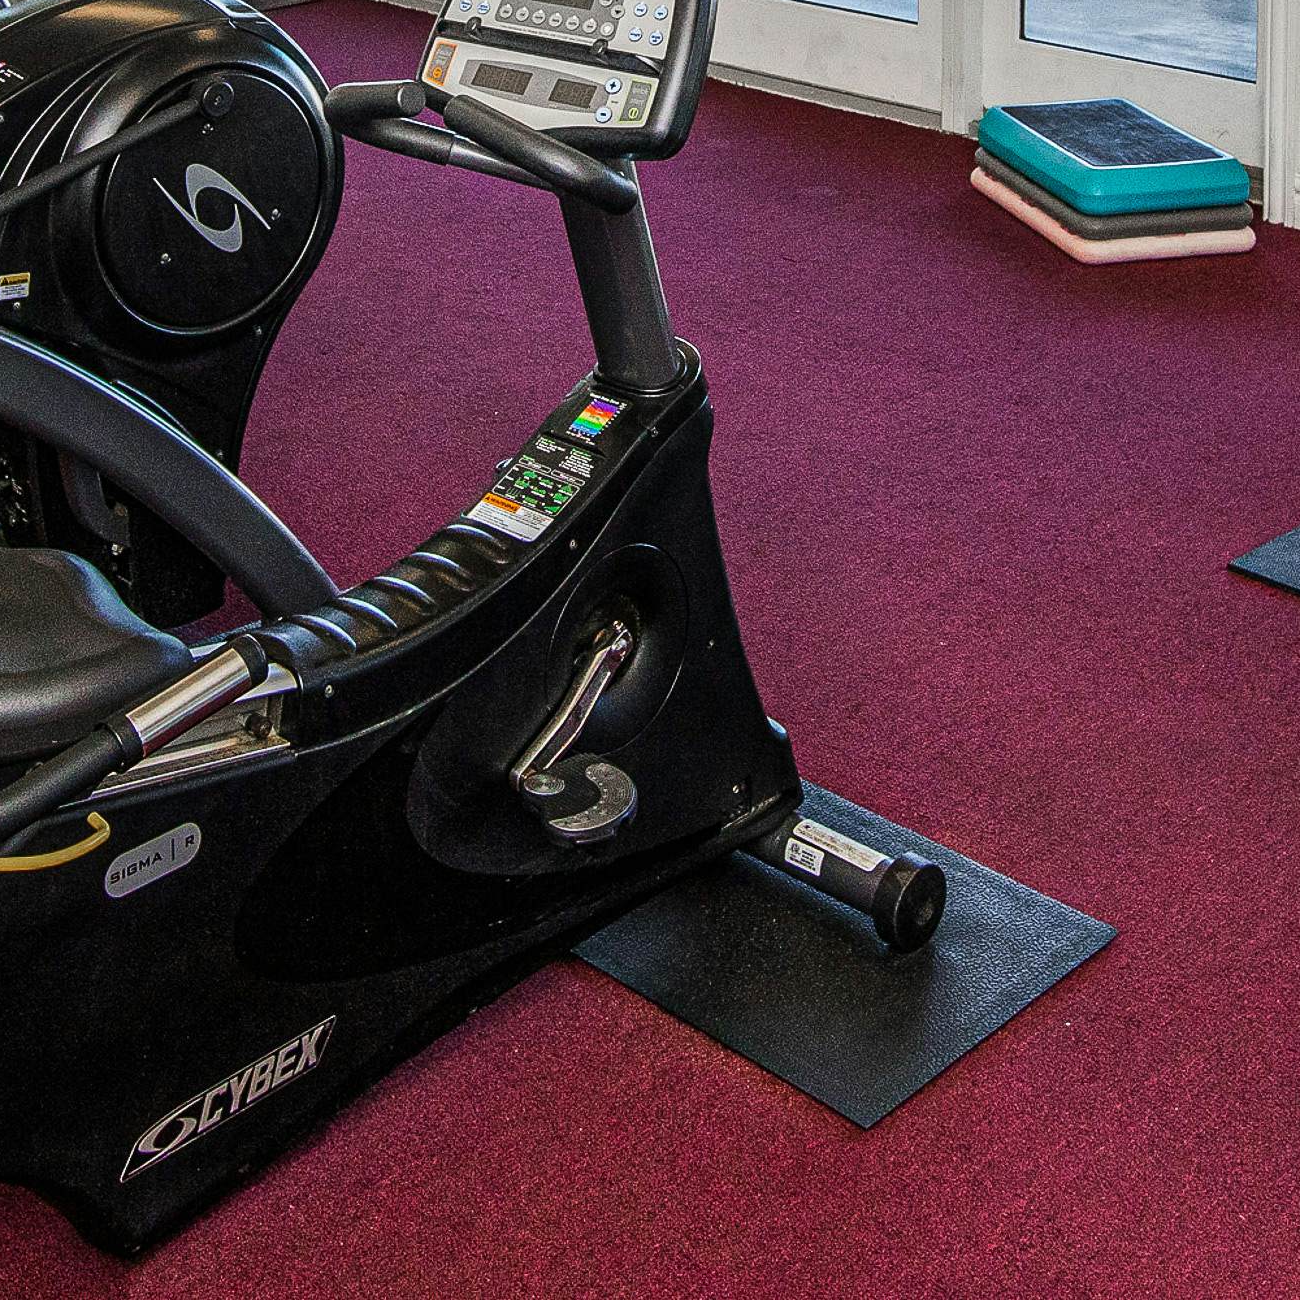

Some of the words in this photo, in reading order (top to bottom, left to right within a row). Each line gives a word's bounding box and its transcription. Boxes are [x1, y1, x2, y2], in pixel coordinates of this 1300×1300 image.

[110, 852, 163, 884] SIGMA
[185, 834, 195, 848] R
[198, 1026, 325, 1133] CYBEX
